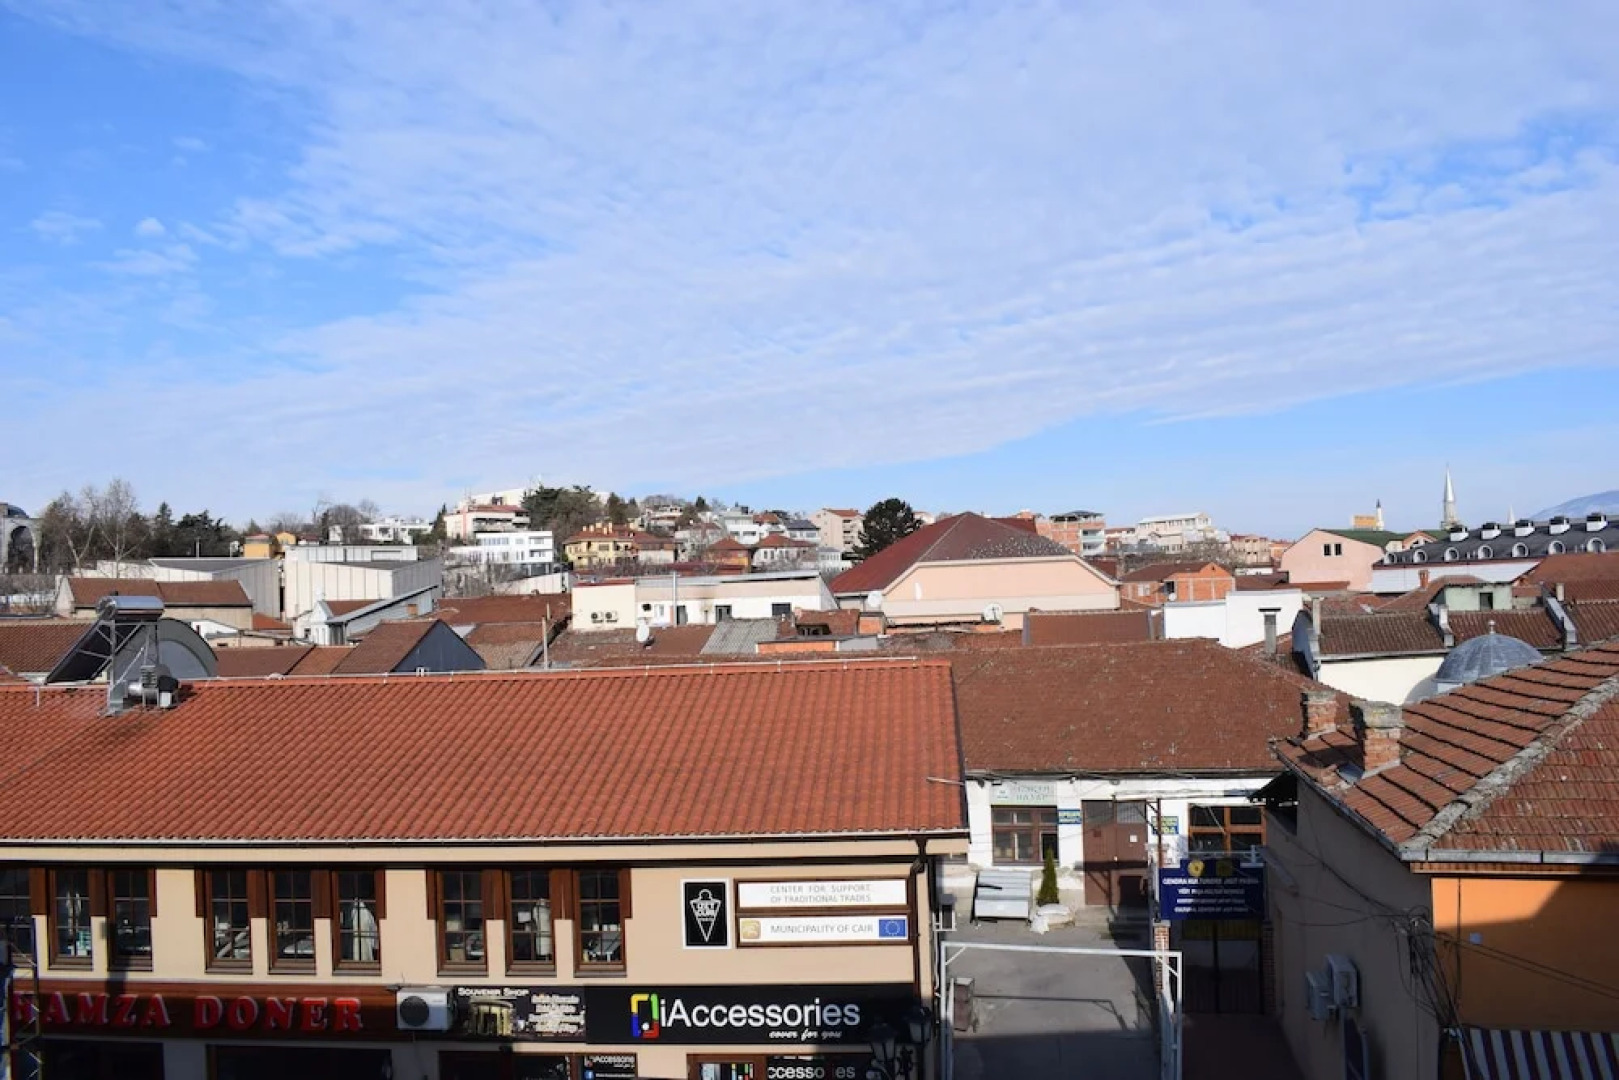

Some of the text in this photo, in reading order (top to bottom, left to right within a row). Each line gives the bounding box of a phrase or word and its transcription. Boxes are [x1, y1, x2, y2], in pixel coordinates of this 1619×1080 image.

[770, 883, 871, 894] CENTER FOR SUPPORT
[770, 893, 872, 903] OF TRADITIONAL TRADES
[770, 924, 834, 934] MUNICIPALITY
[836, 924, 848, 933] OF
[193, 995, 363, 1033] DONER
[660, 997, 861, 1028] iAccessories
[769, 1028, 843, 1042] cover for you
